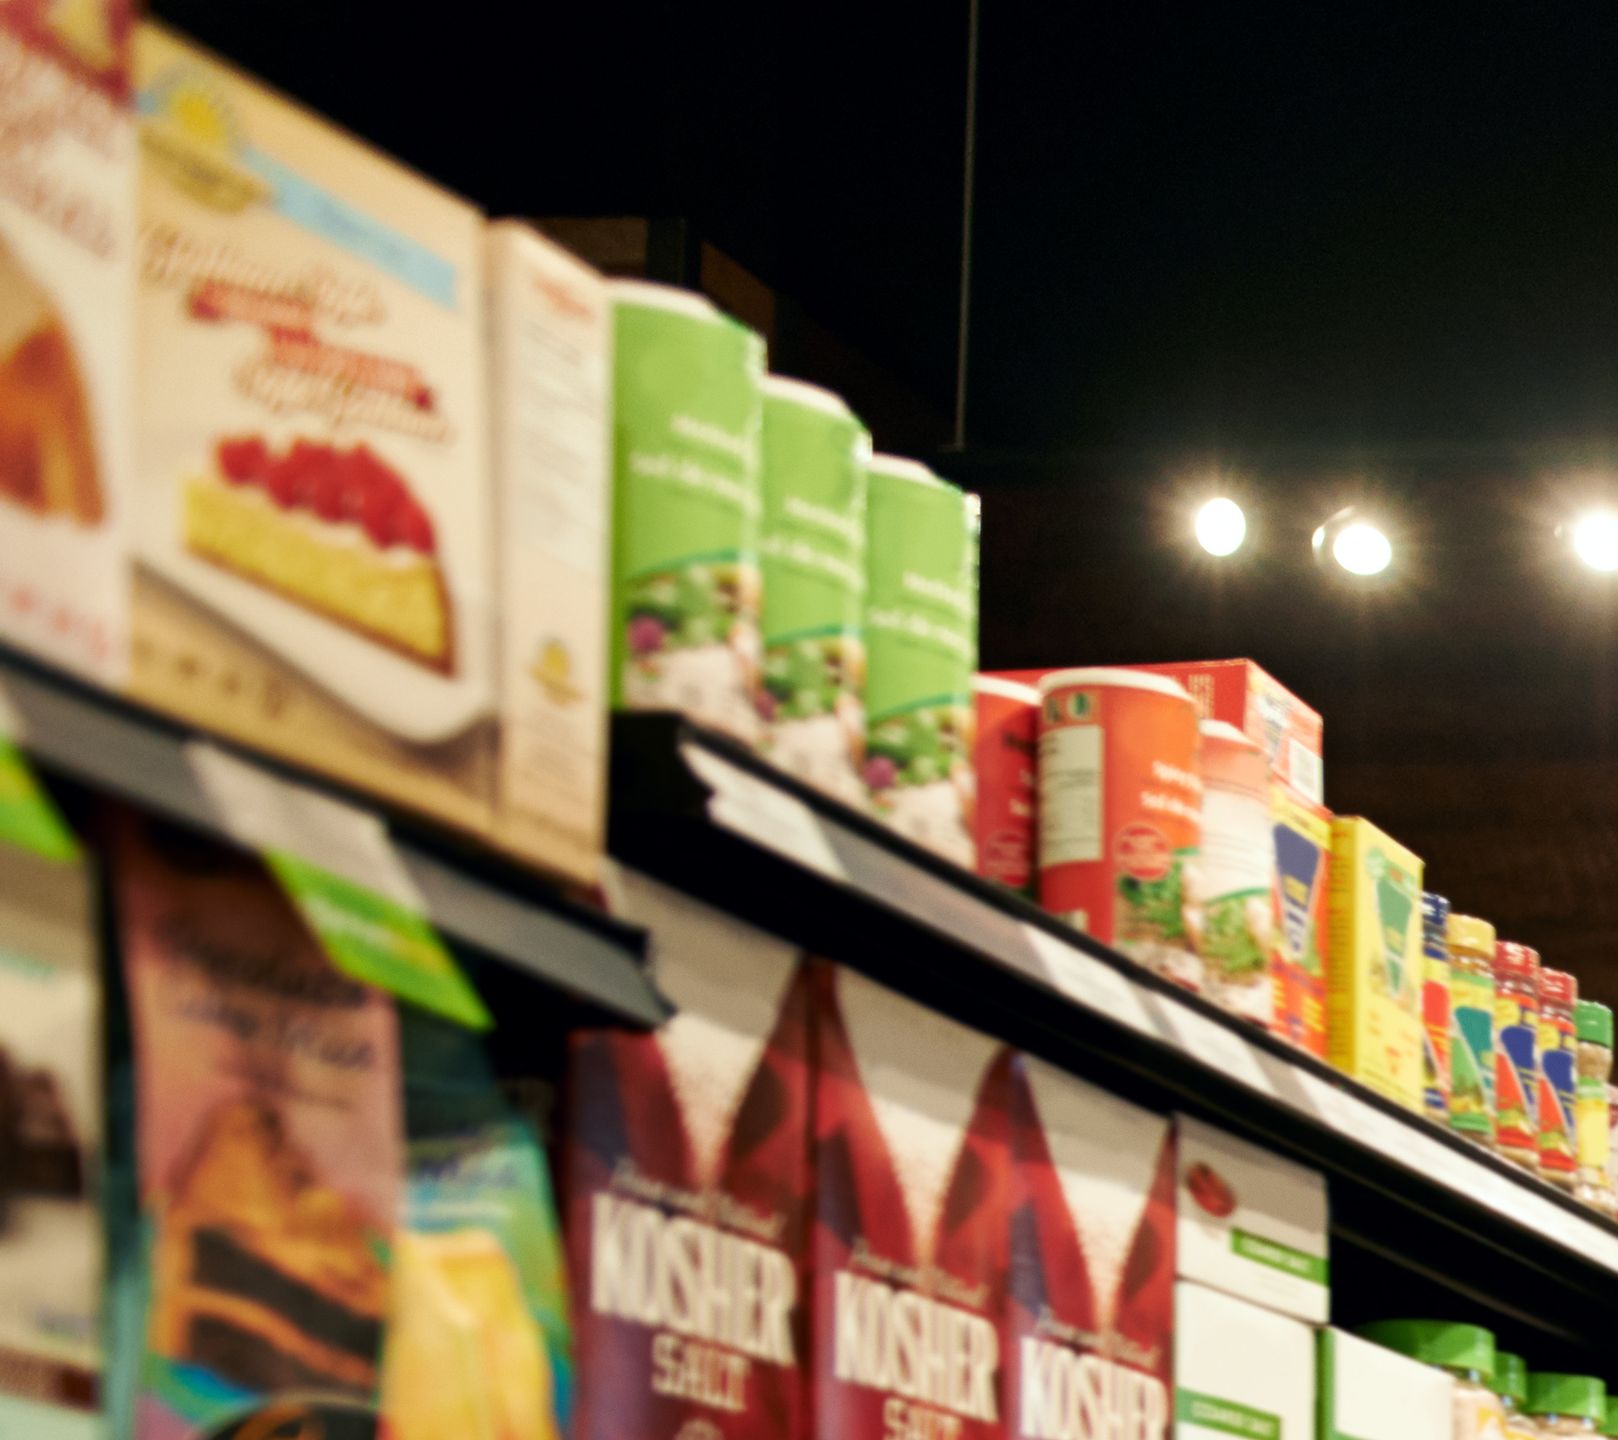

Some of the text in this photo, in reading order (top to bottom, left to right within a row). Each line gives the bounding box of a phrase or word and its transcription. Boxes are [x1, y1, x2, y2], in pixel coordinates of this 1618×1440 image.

[592, 1193, 797, 1366] KOSHER
[834, 1269, 998, 1423] KOSHER
[652, 1335, 748, 1411] SALT
